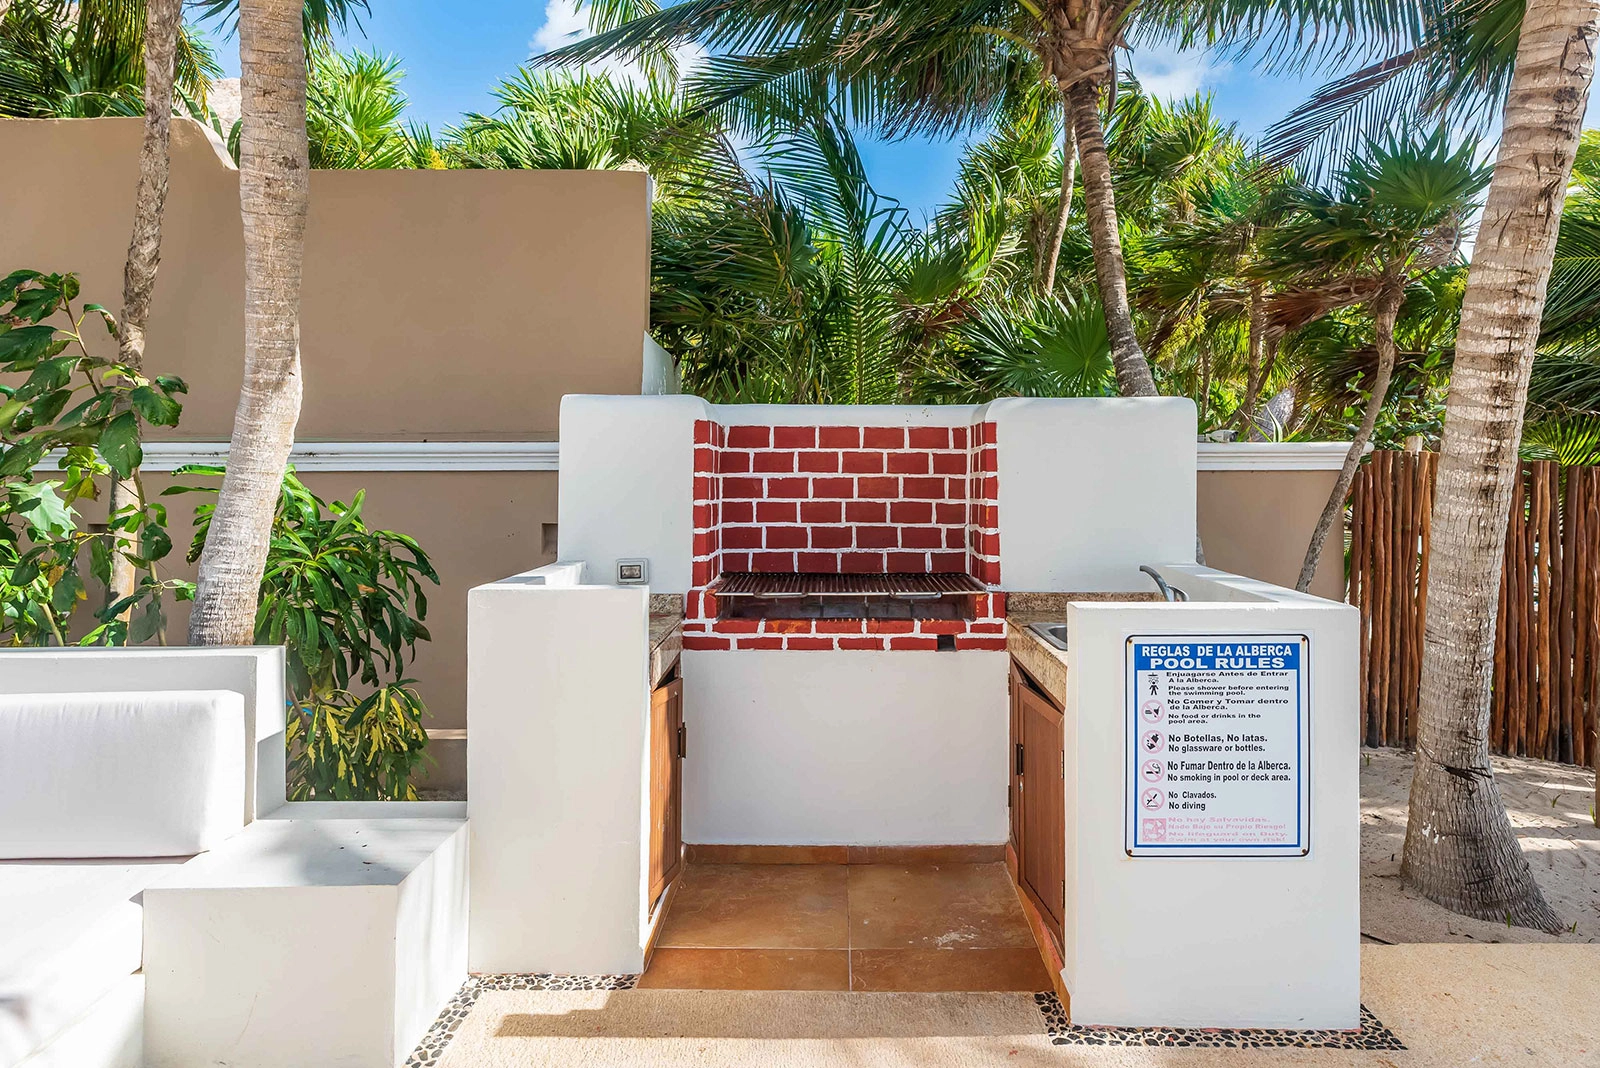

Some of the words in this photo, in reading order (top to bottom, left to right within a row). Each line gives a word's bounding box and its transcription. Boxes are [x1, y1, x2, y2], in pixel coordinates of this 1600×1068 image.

[1142, 646, 1190, 656] REGLAS
[1197, 646, 1213, 656] DE
[1217, 646, 1232, 656] LA
[1236, 645, 1292, 656] ALBERCA
[1150, 658, 1208, 668] POOL
[1215, 658, 1285, 668] RULES
[1184, 734, 1224, 743] Botellas,
[1182, 745, 1222, 753] glassware
[1168, 762, 1178, 770] No
[1181, 761, 1205, 770] Fumar
[1208, 761, 1234, 770] Dentro
[1237, 761, 1246, 770] de
[1248, 761, 1255, 770] la
[1258, 761, 1291, 770] Alberca.
[1180, 774, 1211, 783] smoking
[1223, 774, 1239, 783] pool
[1182, 802, 1206, 811] diving
